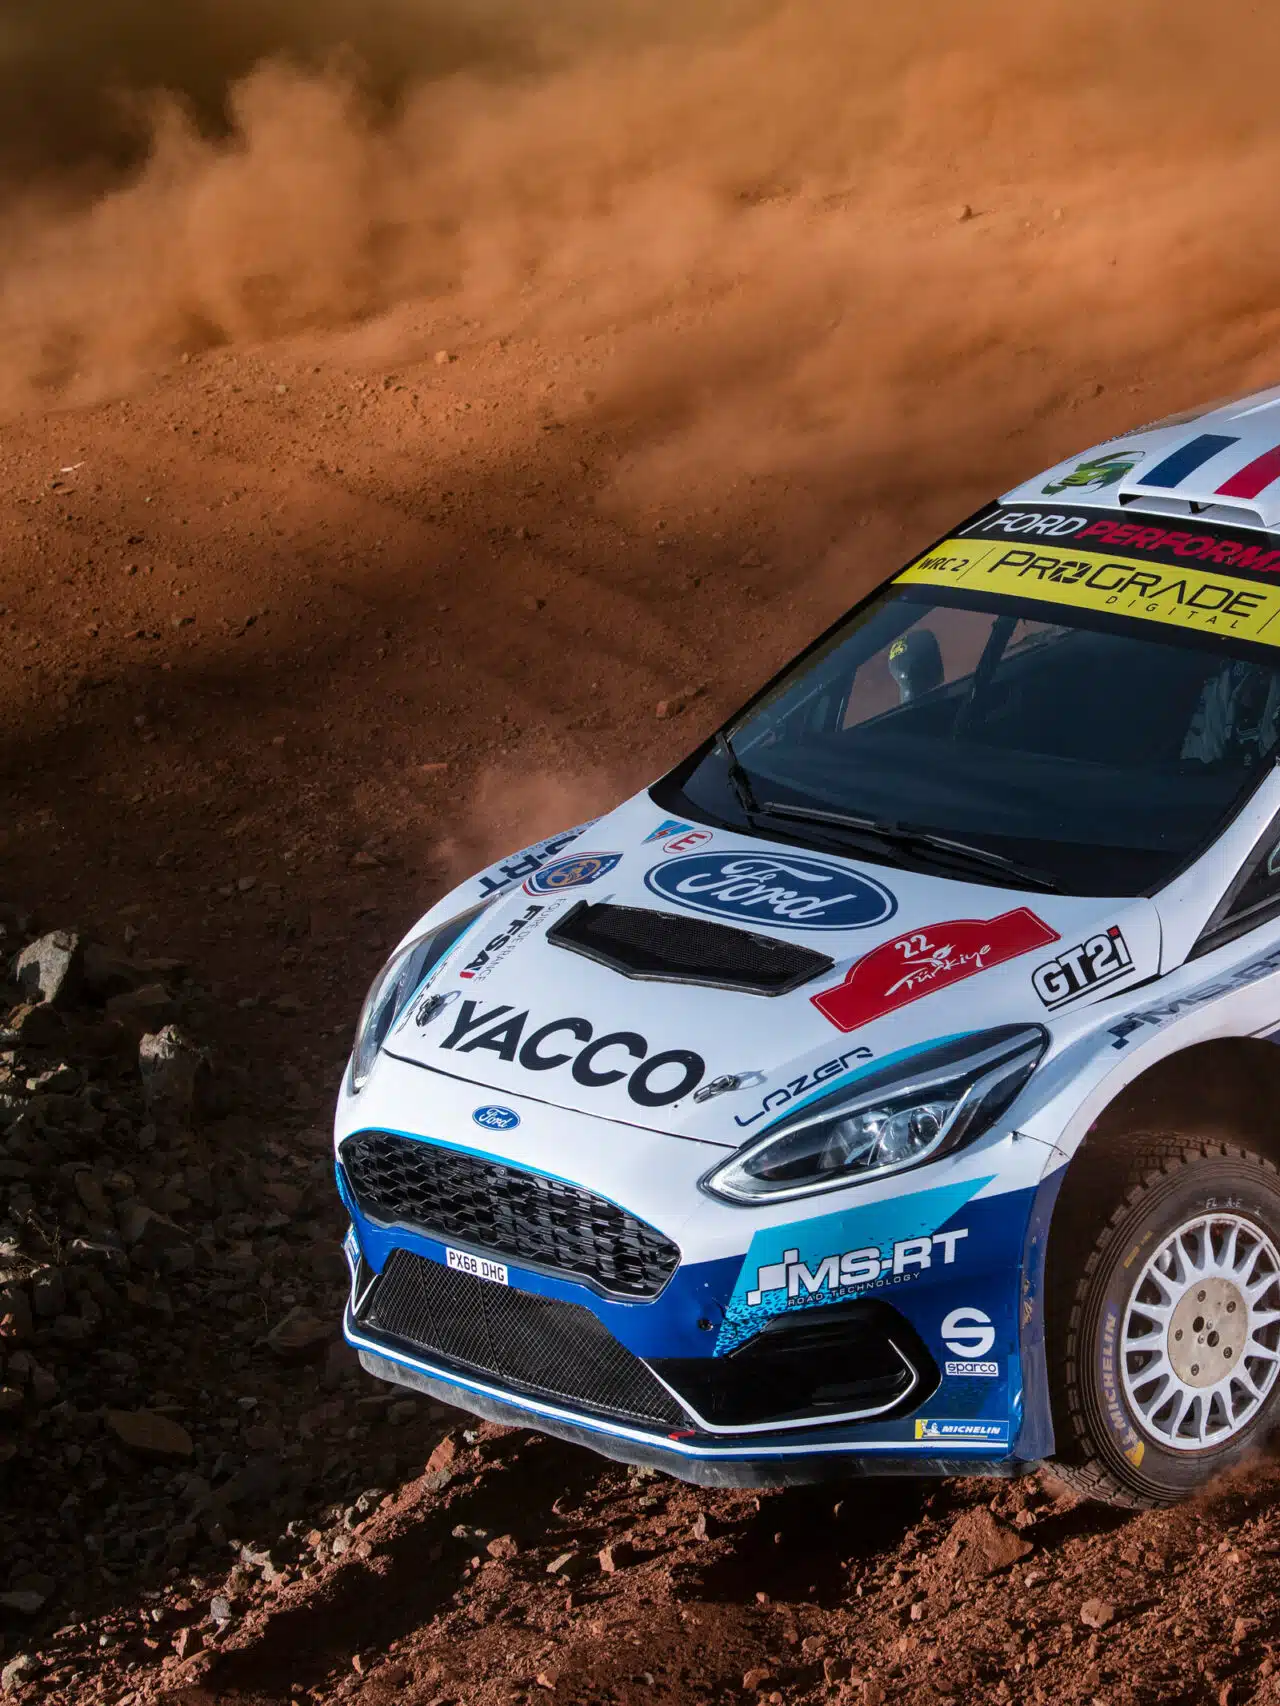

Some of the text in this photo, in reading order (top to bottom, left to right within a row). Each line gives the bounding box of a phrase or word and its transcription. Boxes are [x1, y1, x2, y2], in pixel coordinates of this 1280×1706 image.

[982, 513, 1087, 536] FORD
[918, 557, 970, 572] WRC 2
[1105, 596, 1239, 630] DIGITAL
[676, 859, 857, 919] Ford
[894, 934, 936, 959] 22
[1031, 924, 1133, 1007] GT2i
[439, 1000, 706, 1108] YACCO
[734, 1047, 874, 1127] LAZER
[478, 1108, 513, 1128] Ford
[449, 1250, 505, 1282] PX68 DHG
[788, 1272, 921, 1306] ROAD TECHNOLOGY
[947, 1362, 997, 1375] sparco
[1101, 1312, 1128, 1431] MICHELIN
[941, 1425, 1001, 1435] MICHELIN
